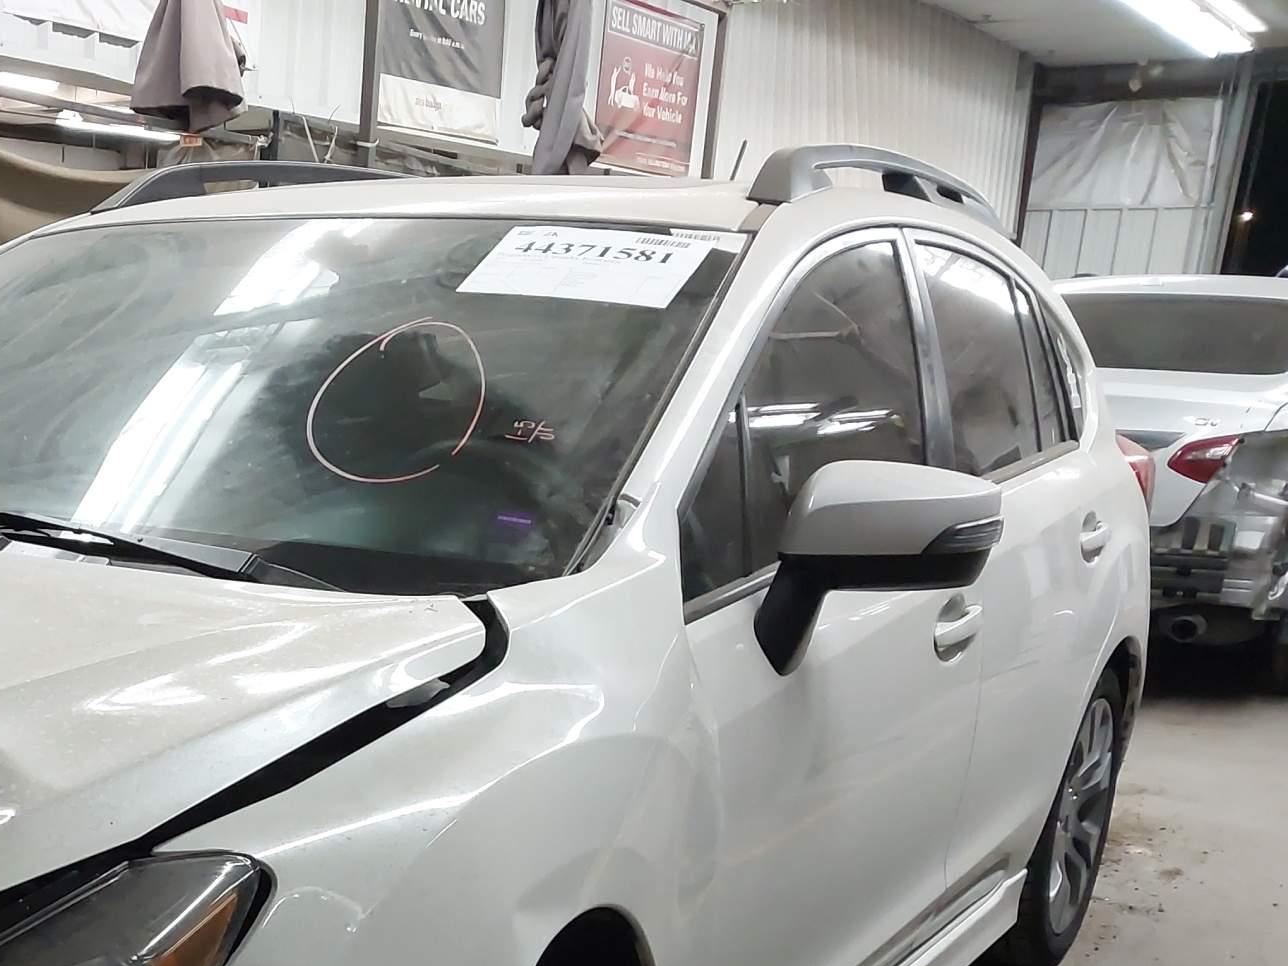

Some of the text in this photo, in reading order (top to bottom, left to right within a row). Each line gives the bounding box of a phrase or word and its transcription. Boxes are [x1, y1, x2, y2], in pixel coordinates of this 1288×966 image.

[451, 0, 486, 25] CARS
[611, 6, 631, 33] SELL
[632, 13, 662, 42] SMART
[663, 23, 683, 50] WITH
[657, 105, 682, 124] Vehicle
[515, 240, 674, 264] 44371581
